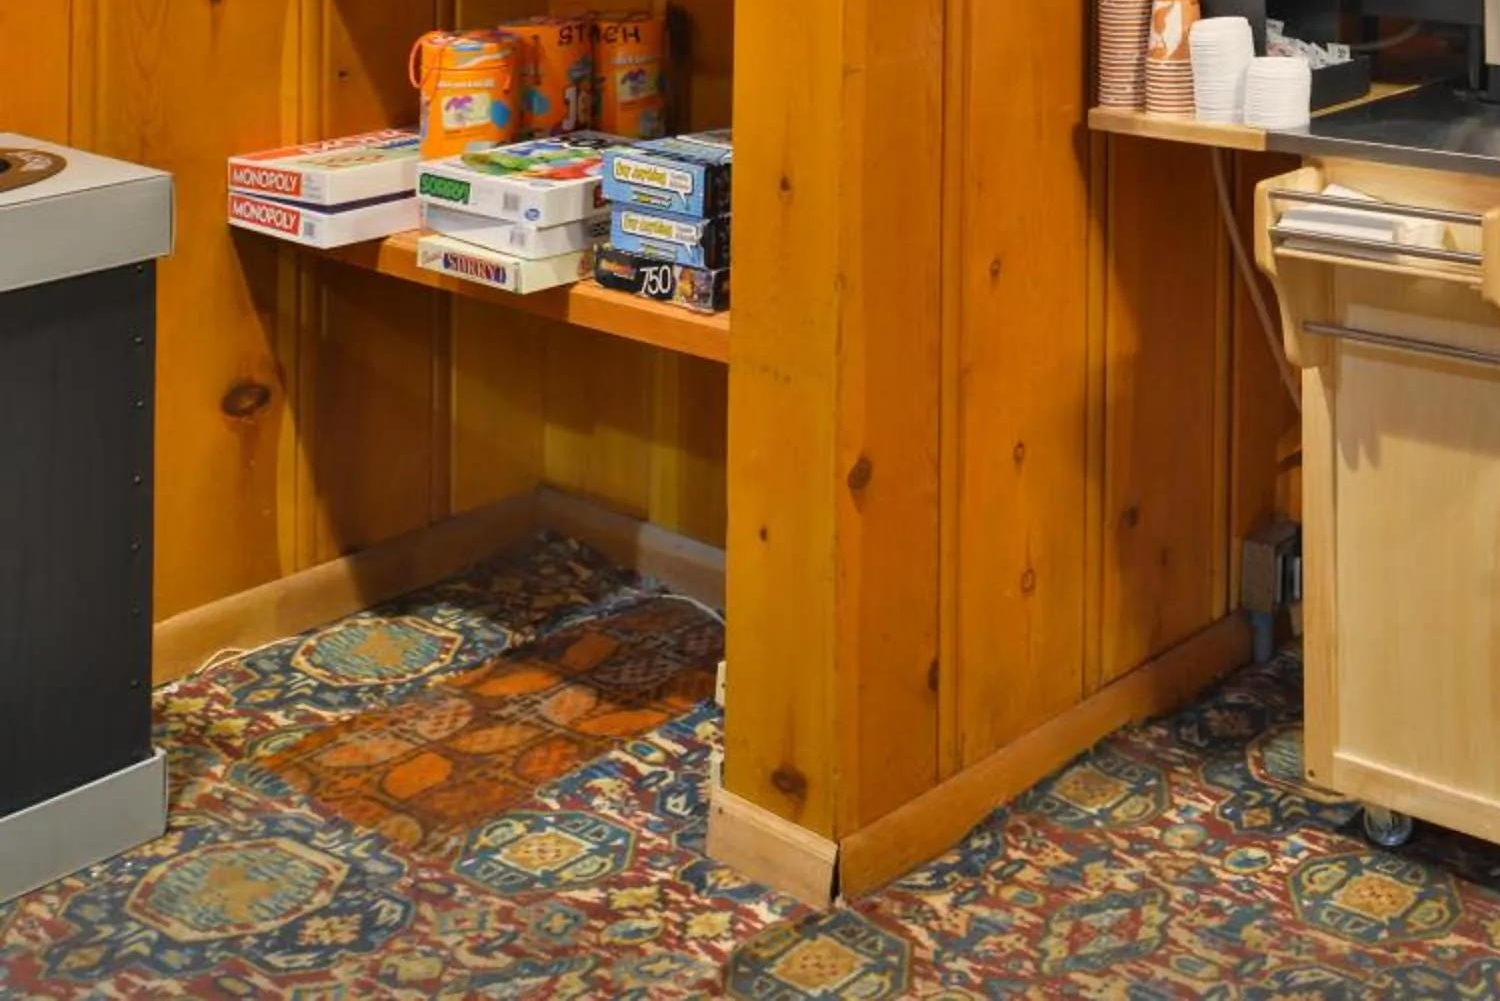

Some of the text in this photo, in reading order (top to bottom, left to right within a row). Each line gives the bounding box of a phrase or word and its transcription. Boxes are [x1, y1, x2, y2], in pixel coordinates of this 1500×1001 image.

[232, 168, 298, 192] MONOPOLY
[232, 200, 297, 230] MONOPOLY
[640, 265, 672, 296] 750
